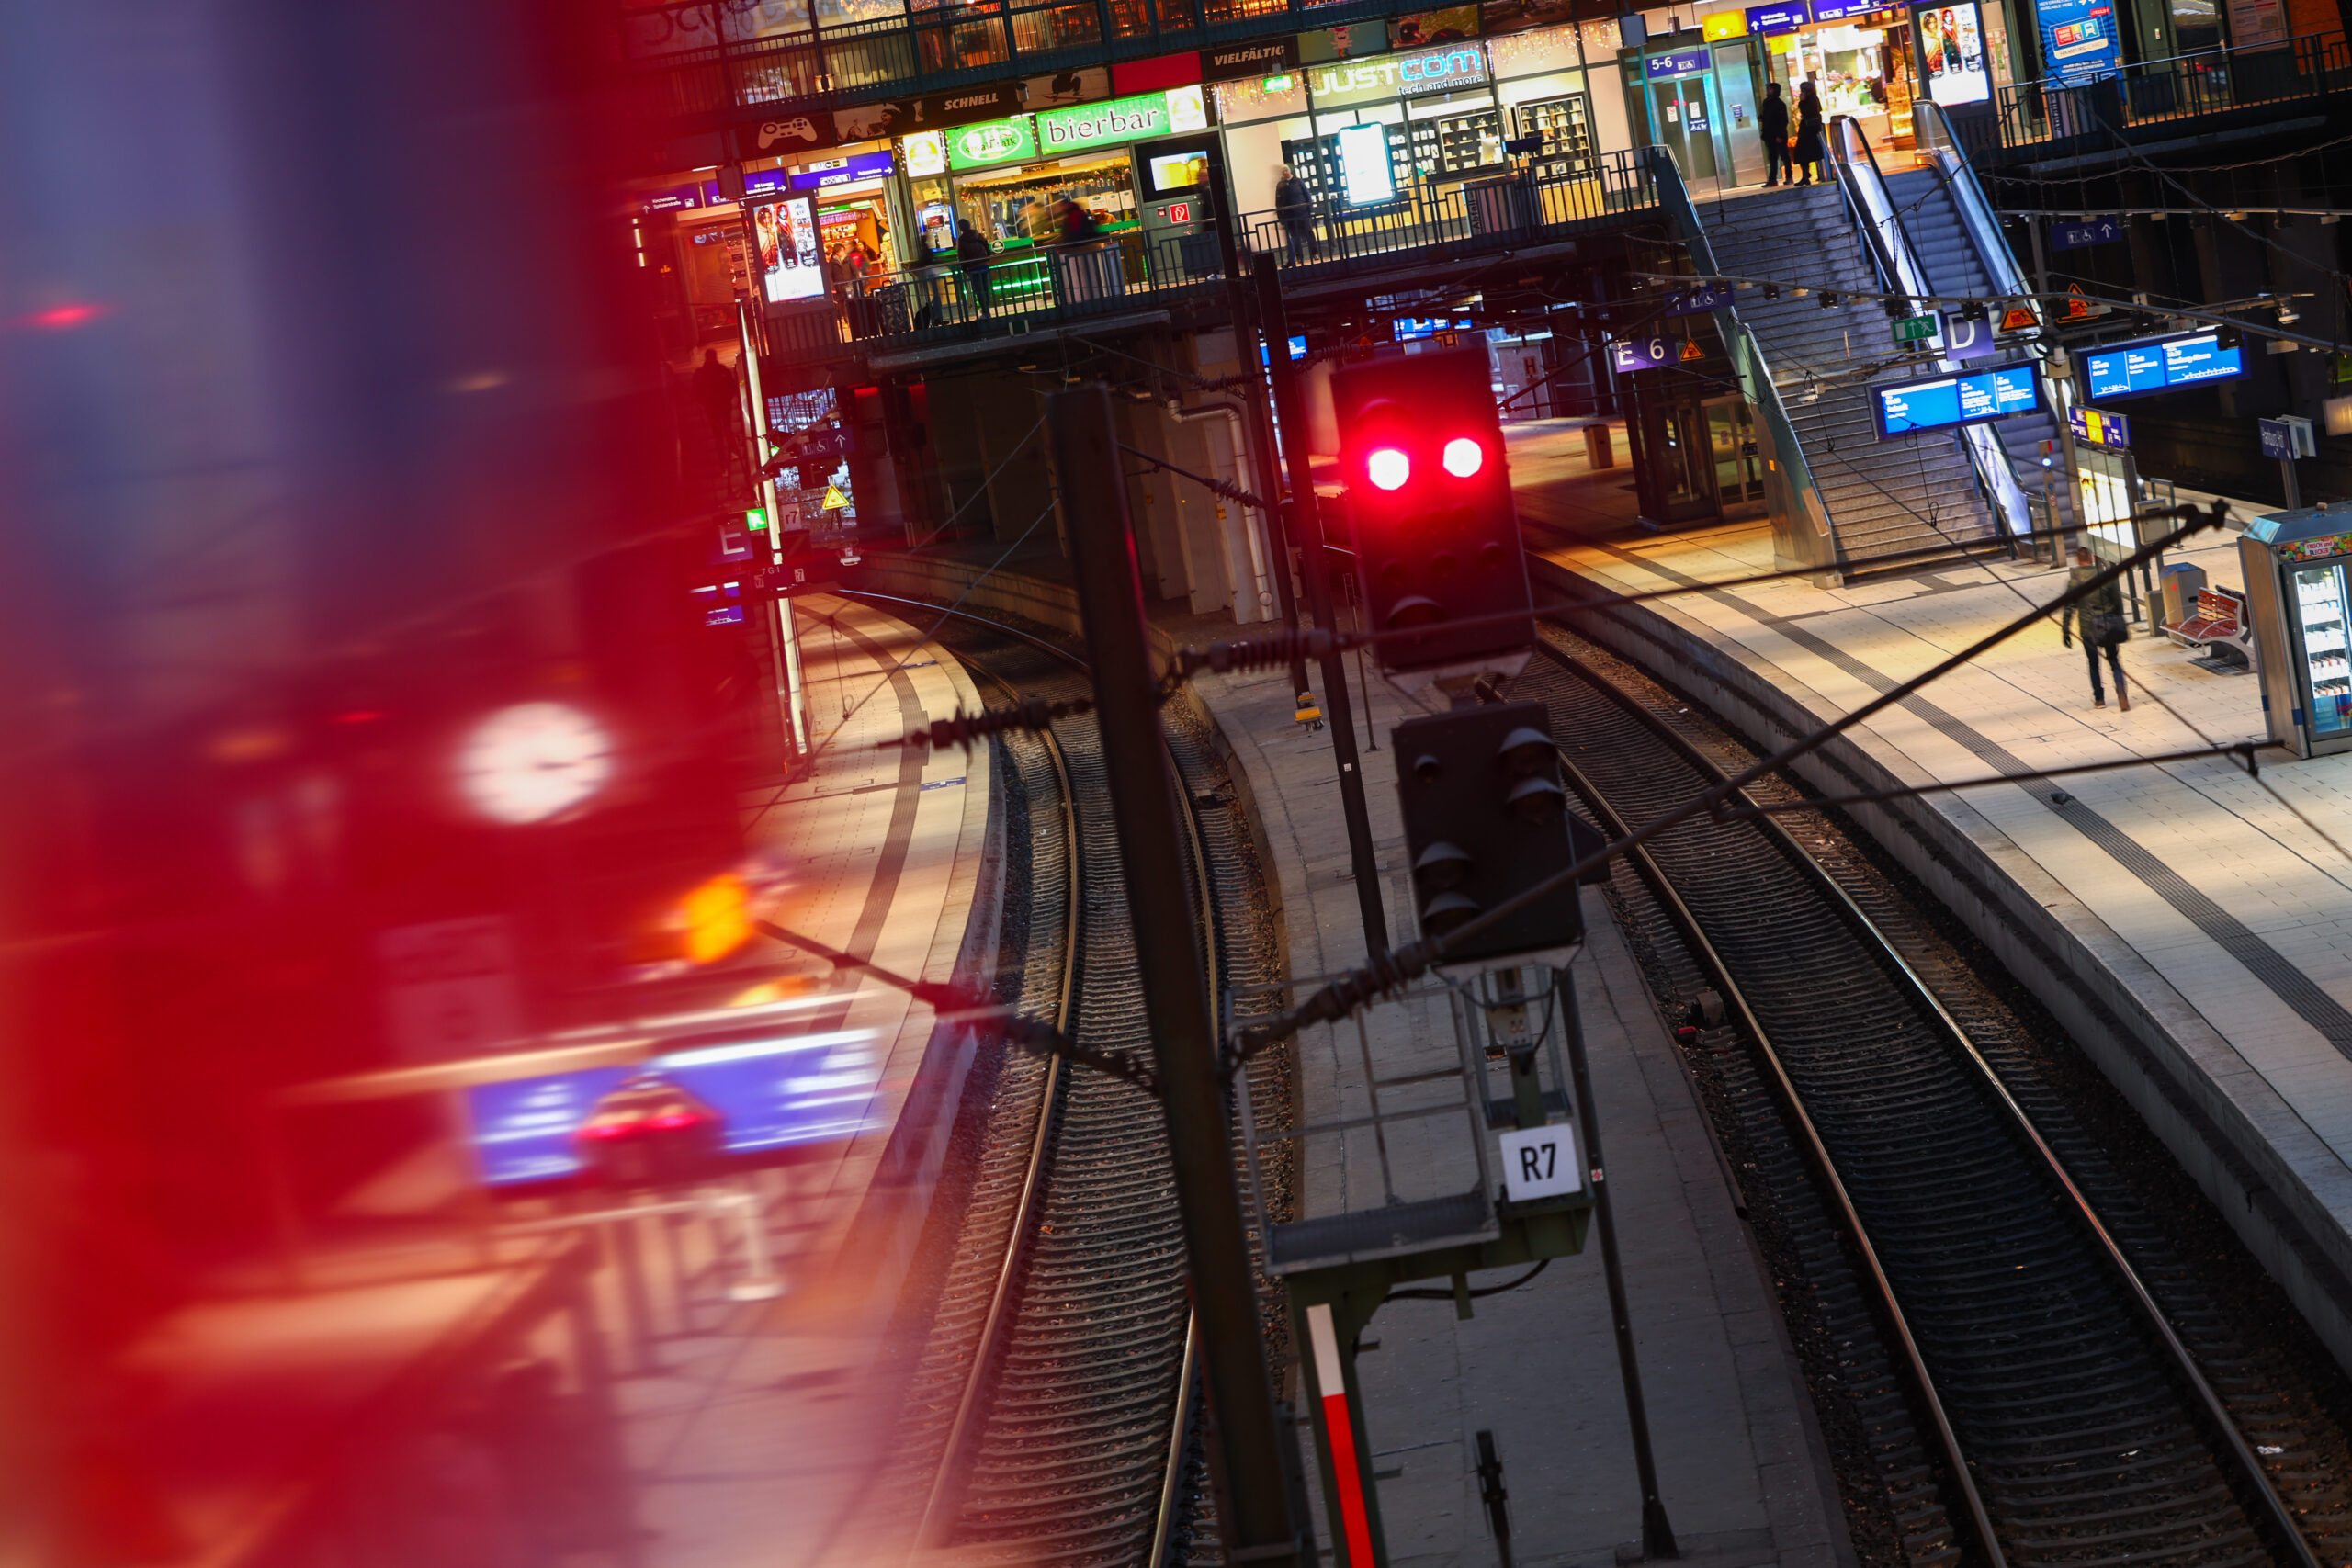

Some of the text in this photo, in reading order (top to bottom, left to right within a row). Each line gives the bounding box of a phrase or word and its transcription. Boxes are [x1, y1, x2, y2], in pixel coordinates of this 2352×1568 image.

[1213, 44, 1286, 67] VIELFÄLTIG
[1652, 56, 1674, 71] 5-6
[1398, 73, 1484, 96] tech and more
[944, 92, 999, 110] SCHNELL
[1048, 107, 1159, 143] bierbar
[1468, 199, 1481, 229] Abfall
[1947, 312, 1975, 350] D
[1616, 338, 1665, 366] E 6
[1520, 1143, 1555, 1182] R7
